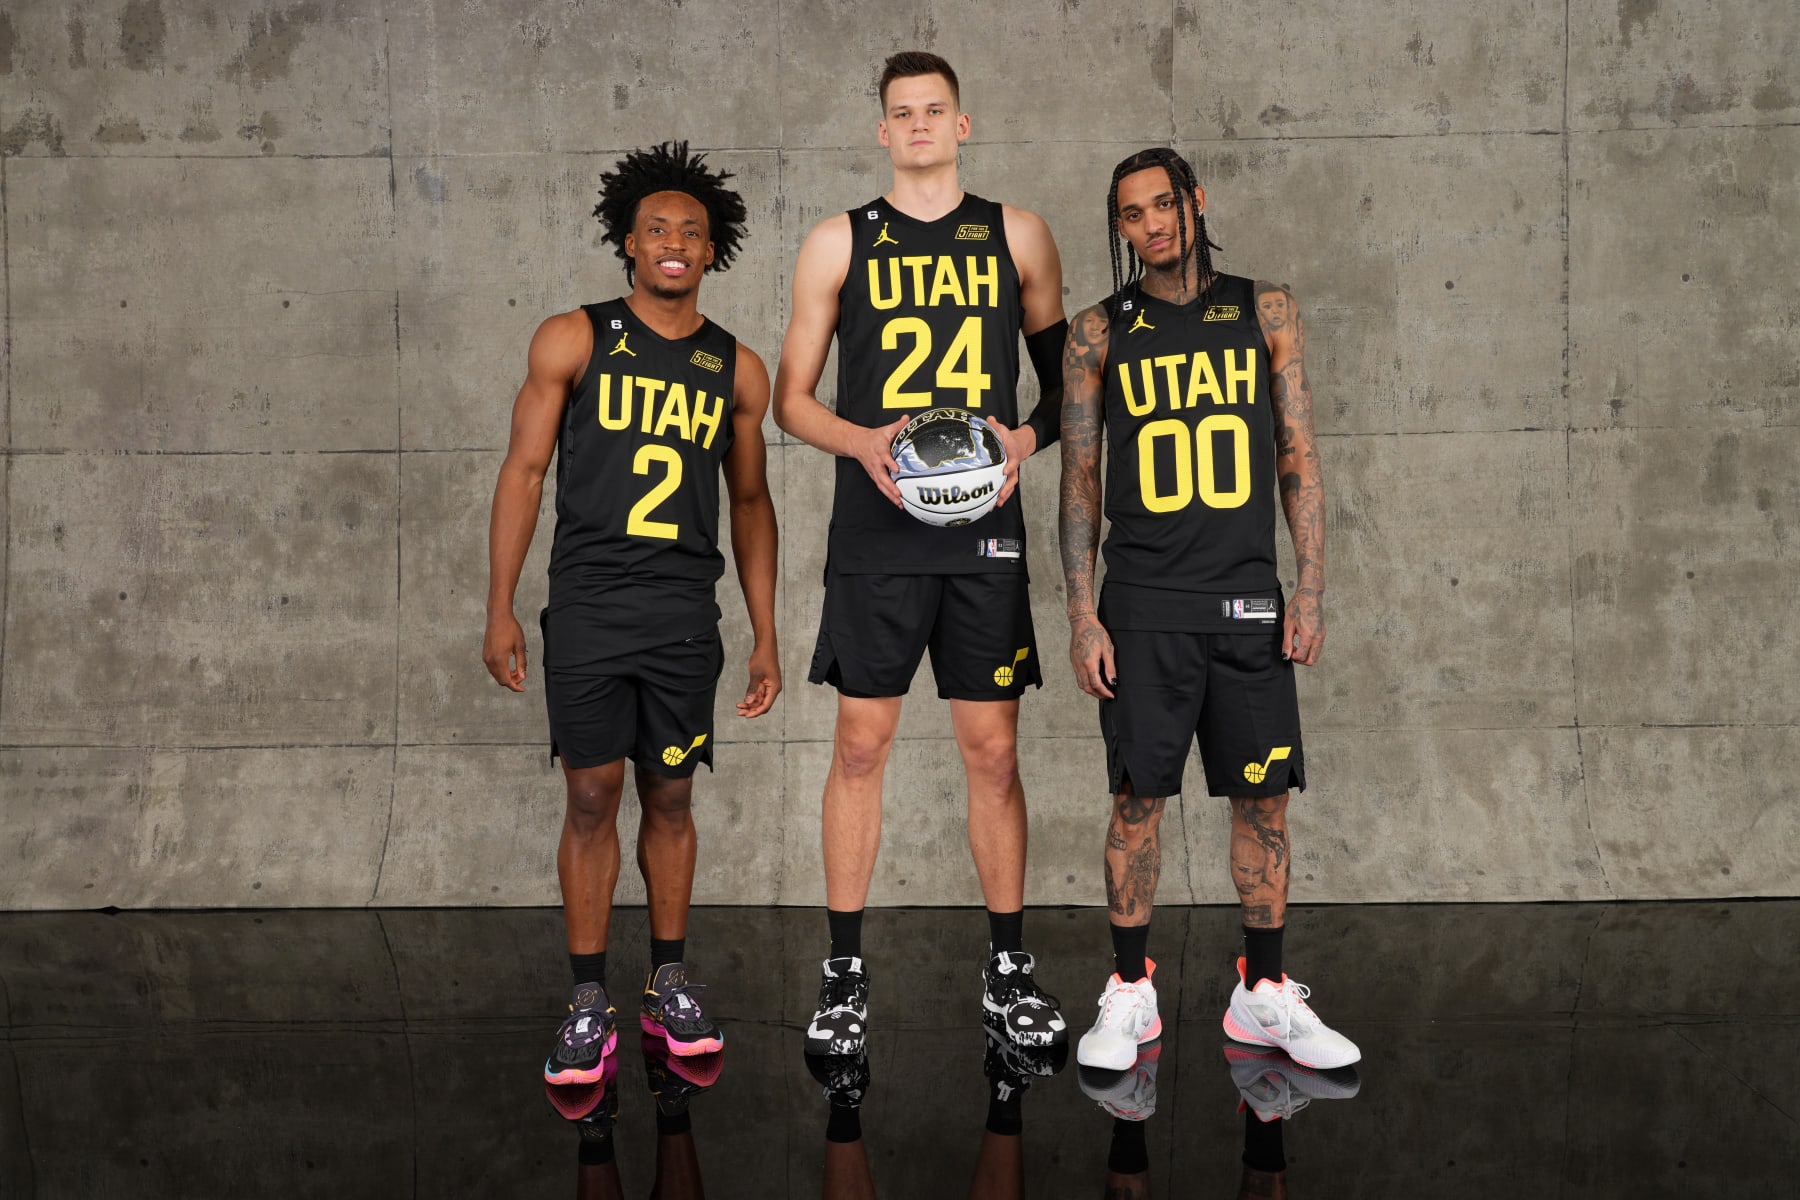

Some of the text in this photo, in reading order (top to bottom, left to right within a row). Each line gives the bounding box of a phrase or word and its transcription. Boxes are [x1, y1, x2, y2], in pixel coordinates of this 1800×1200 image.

[867, 210, 878, 221] 6
[958, 226, 968, 238] 5
[868, 256, 998, 309] UTAH
[1123, 300, 1133, 311] 6
[610, 319, 623, 330] 6
[882, 317, 990, 408] 24
[1119, 349, 1257, 416] UTAH
[599, 374, 724, 449] UTAH
[1138, 415, 1251, 513] 00
[627, 444, 682, 539] 2
[917, 480, 995, 506] Wilson
